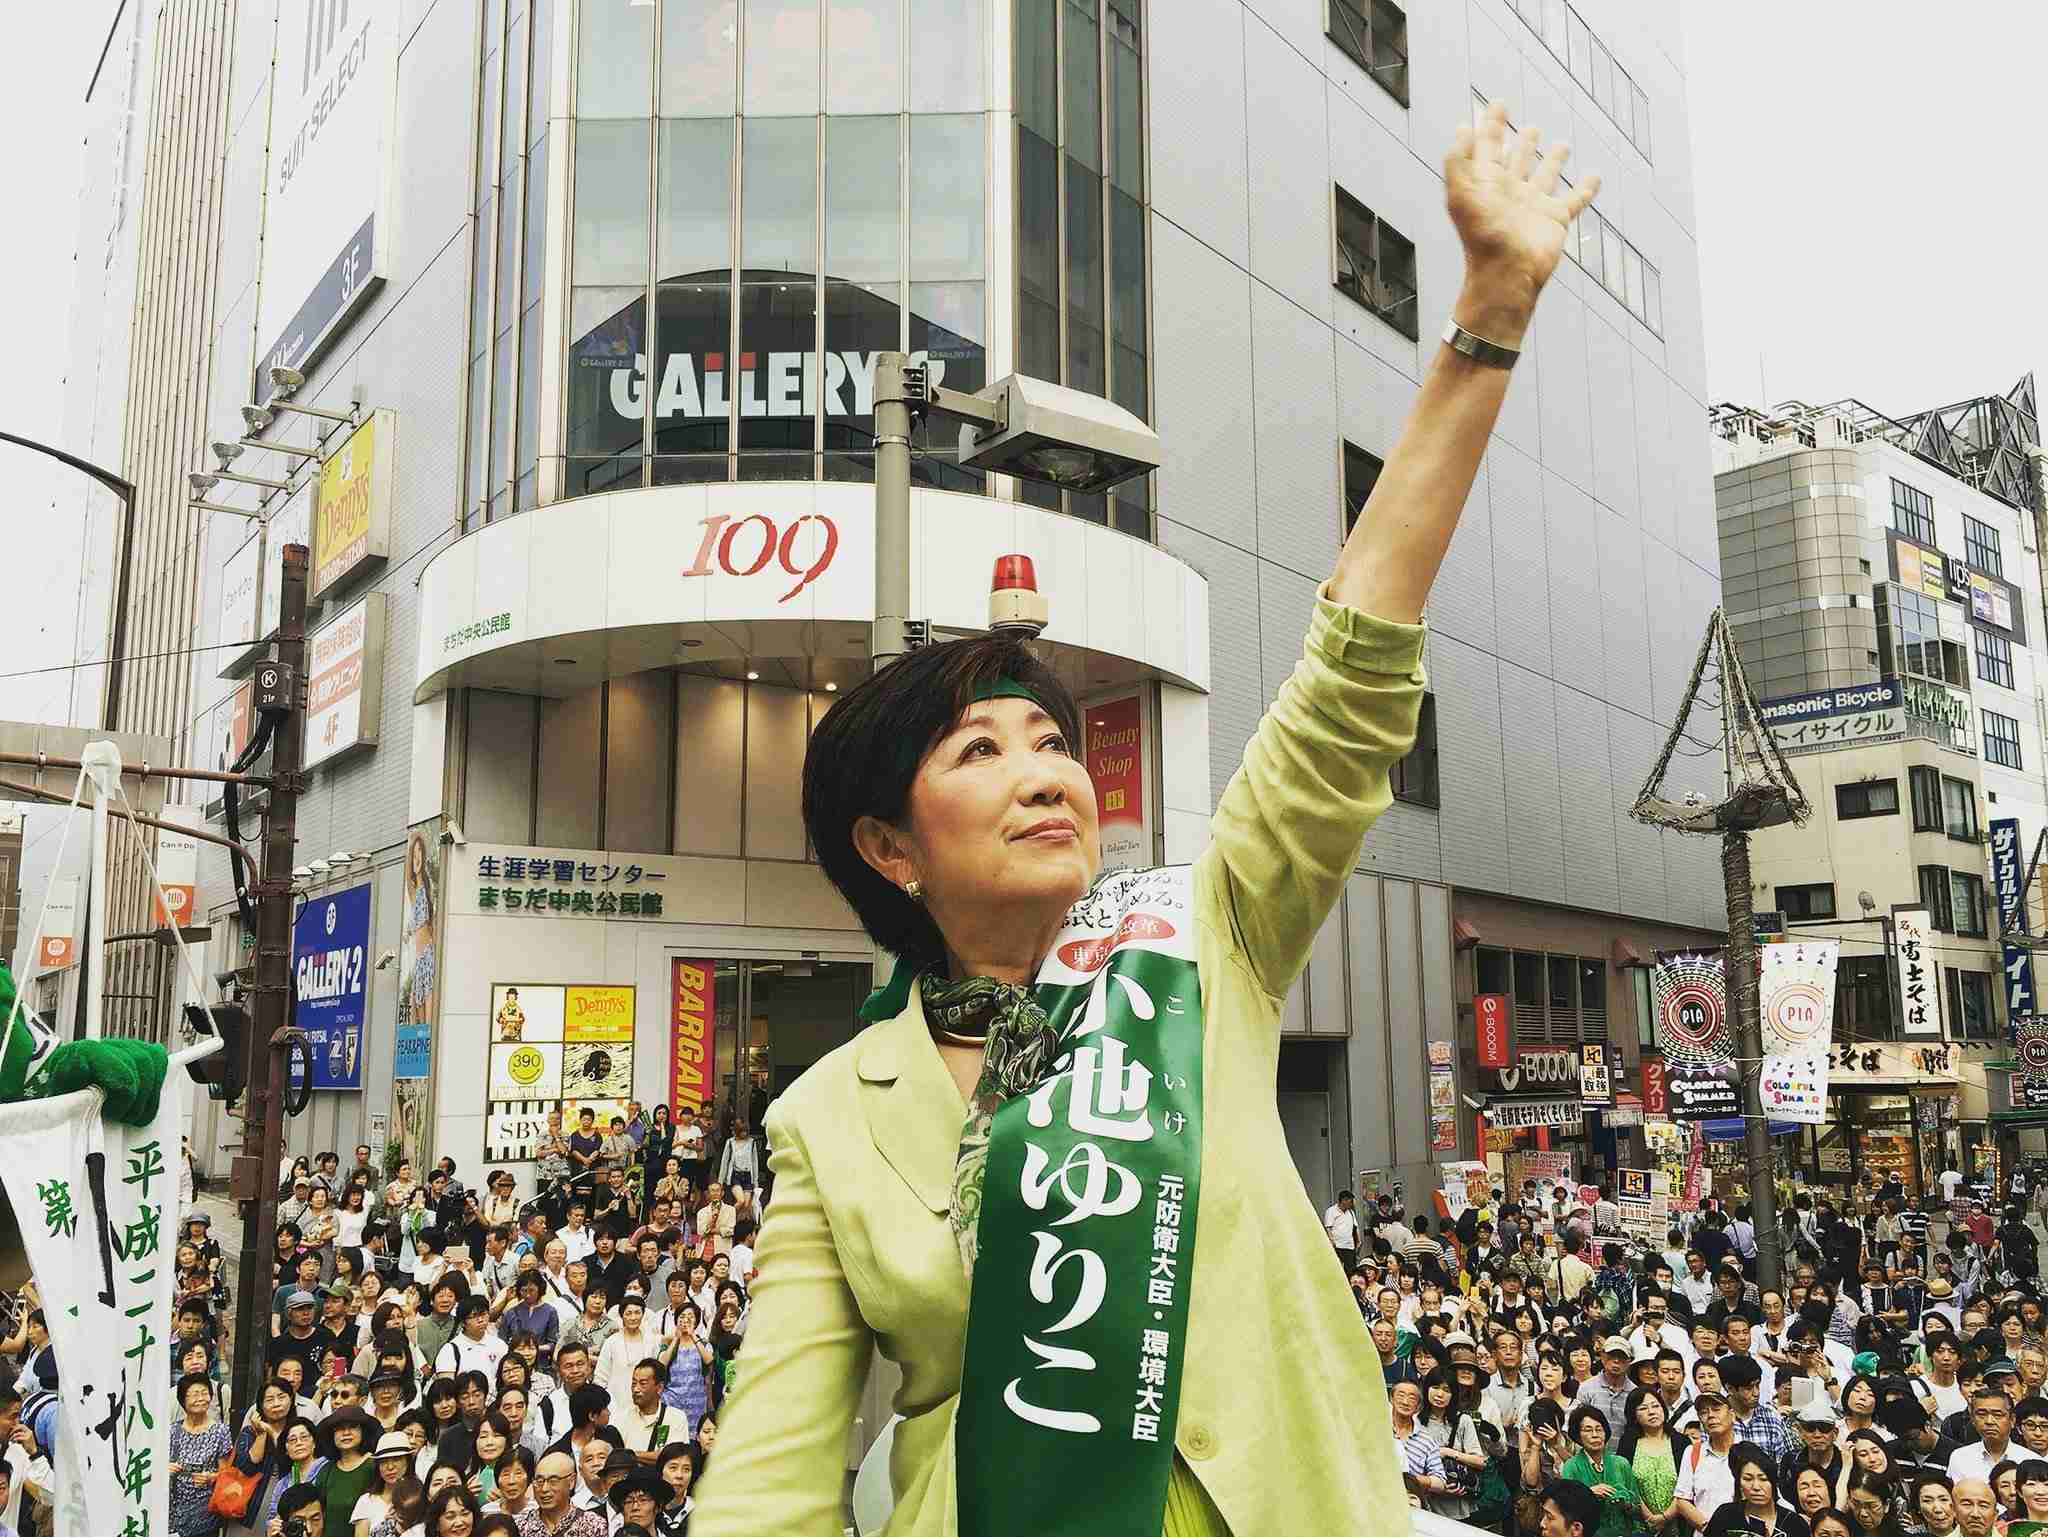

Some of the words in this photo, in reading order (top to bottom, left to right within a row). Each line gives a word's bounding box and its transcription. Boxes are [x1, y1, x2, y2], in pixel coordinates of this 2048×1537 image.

[279, 119, 309, 195] SUIT
[310, 16, 373, 142] SELECT
[342, 243, 361, 300] 3F
[682, 514, 838, 603] 109
[442, 611, 511, 653] まちだ中央公民館
[1835, 686, 1893, 707] Bicycle
[1091, 727, 1139, 751] Beauty
[1770, 711, 1894, 743] トイサイクル
[1097, 755, 1133, 777] Shop
[478, 855, 667, 884] 生涯学習センター
[478, 886, 664, 915] まちだ中央公民館
[1900, 940, 1930, 1025] 富士そば
[575, 994, 625, 1017] Denny's
[1682, 1009, 1704, 1024] PIA
[1787, 1006, 1814, 1024] PIA
[512, 1053, 541, 1068] 390
[1163, 994, 1188, 1137] こいけ
[2031, 1047, 2047, 1058] PIA
[1649, 1064, 1665, 1112] クスリ
[499, 1120, 546, 1140] SBY
[36, 1179, 73, 1239] 第
[1003, 962, 1155, 1434] 小池ゆりこ
[1131, 1173, 1185, 1443] 元防衛大臣・環境大臣
